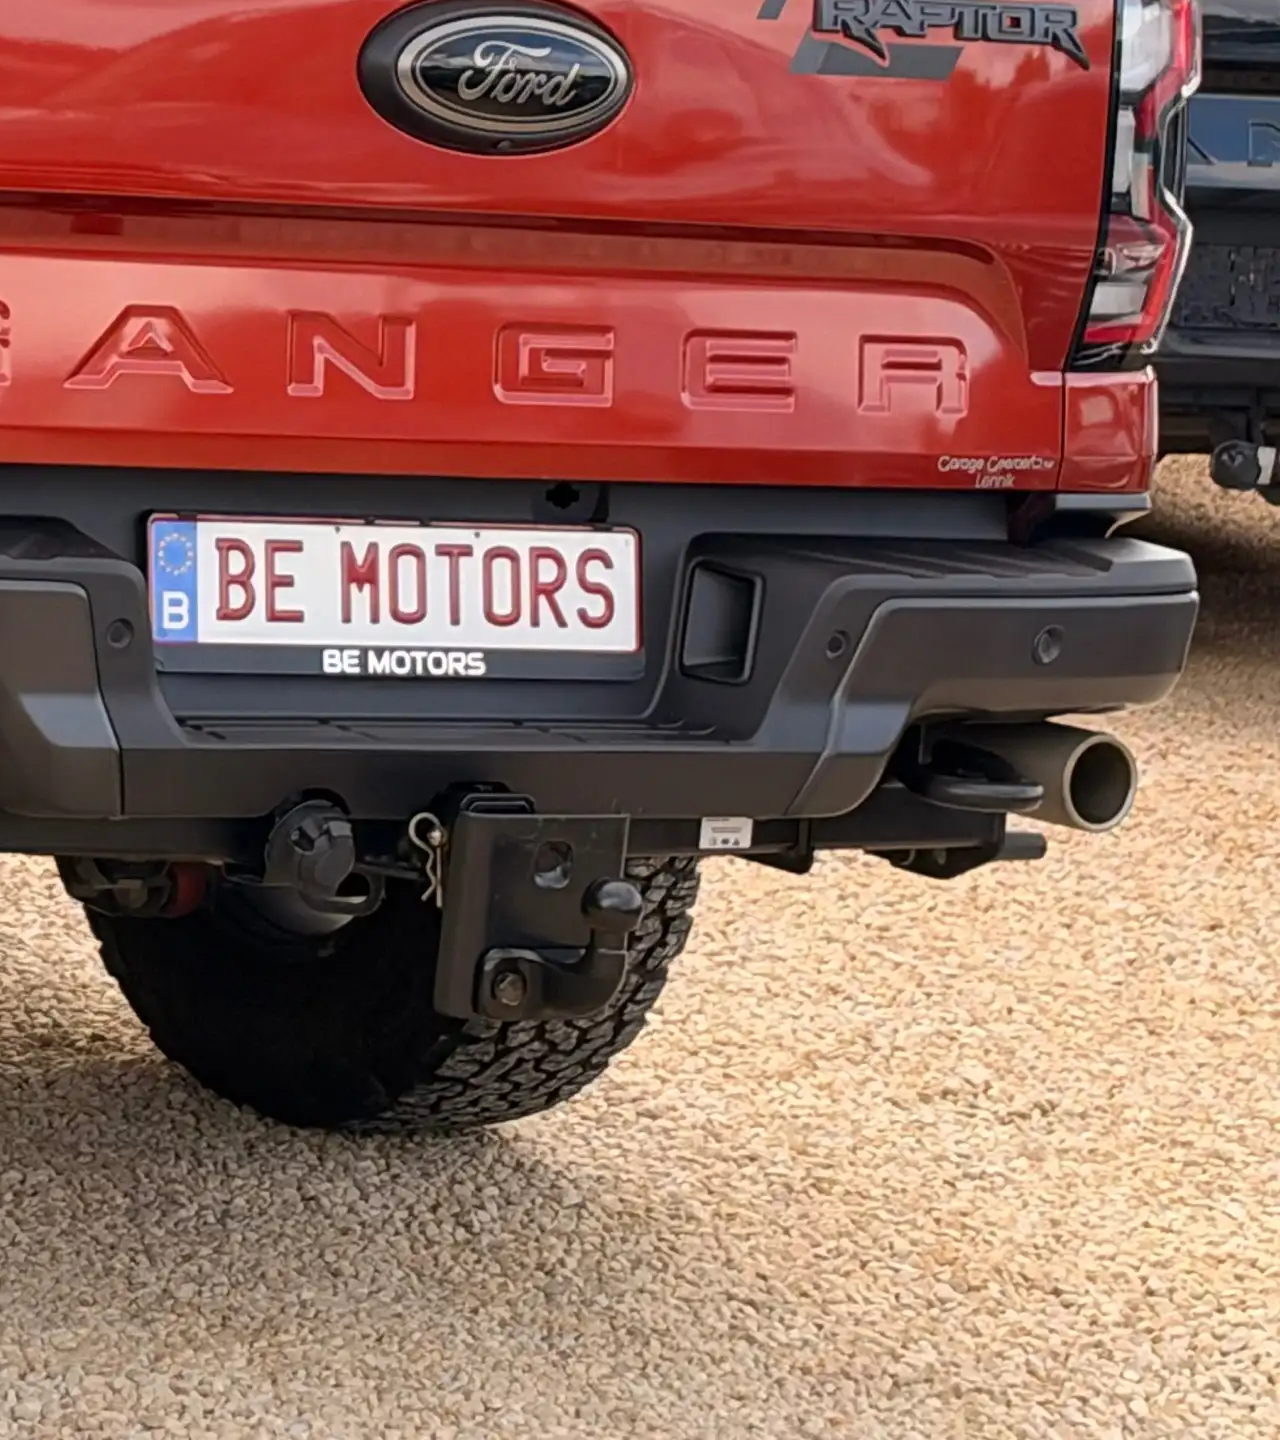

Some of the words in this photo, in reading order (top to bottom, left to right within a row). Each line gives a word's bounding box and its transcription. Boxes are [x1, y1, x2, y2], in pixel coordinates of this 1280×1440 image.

[456, 39, 582, 109] Ford
[214, 536, 306, 624] BE
[339, 539, 616, 630] MOTORS
[161, 591, 191, 630] B
[322, 648, 361, 674] BE
[367, 650, 487, 677] MOTORS
